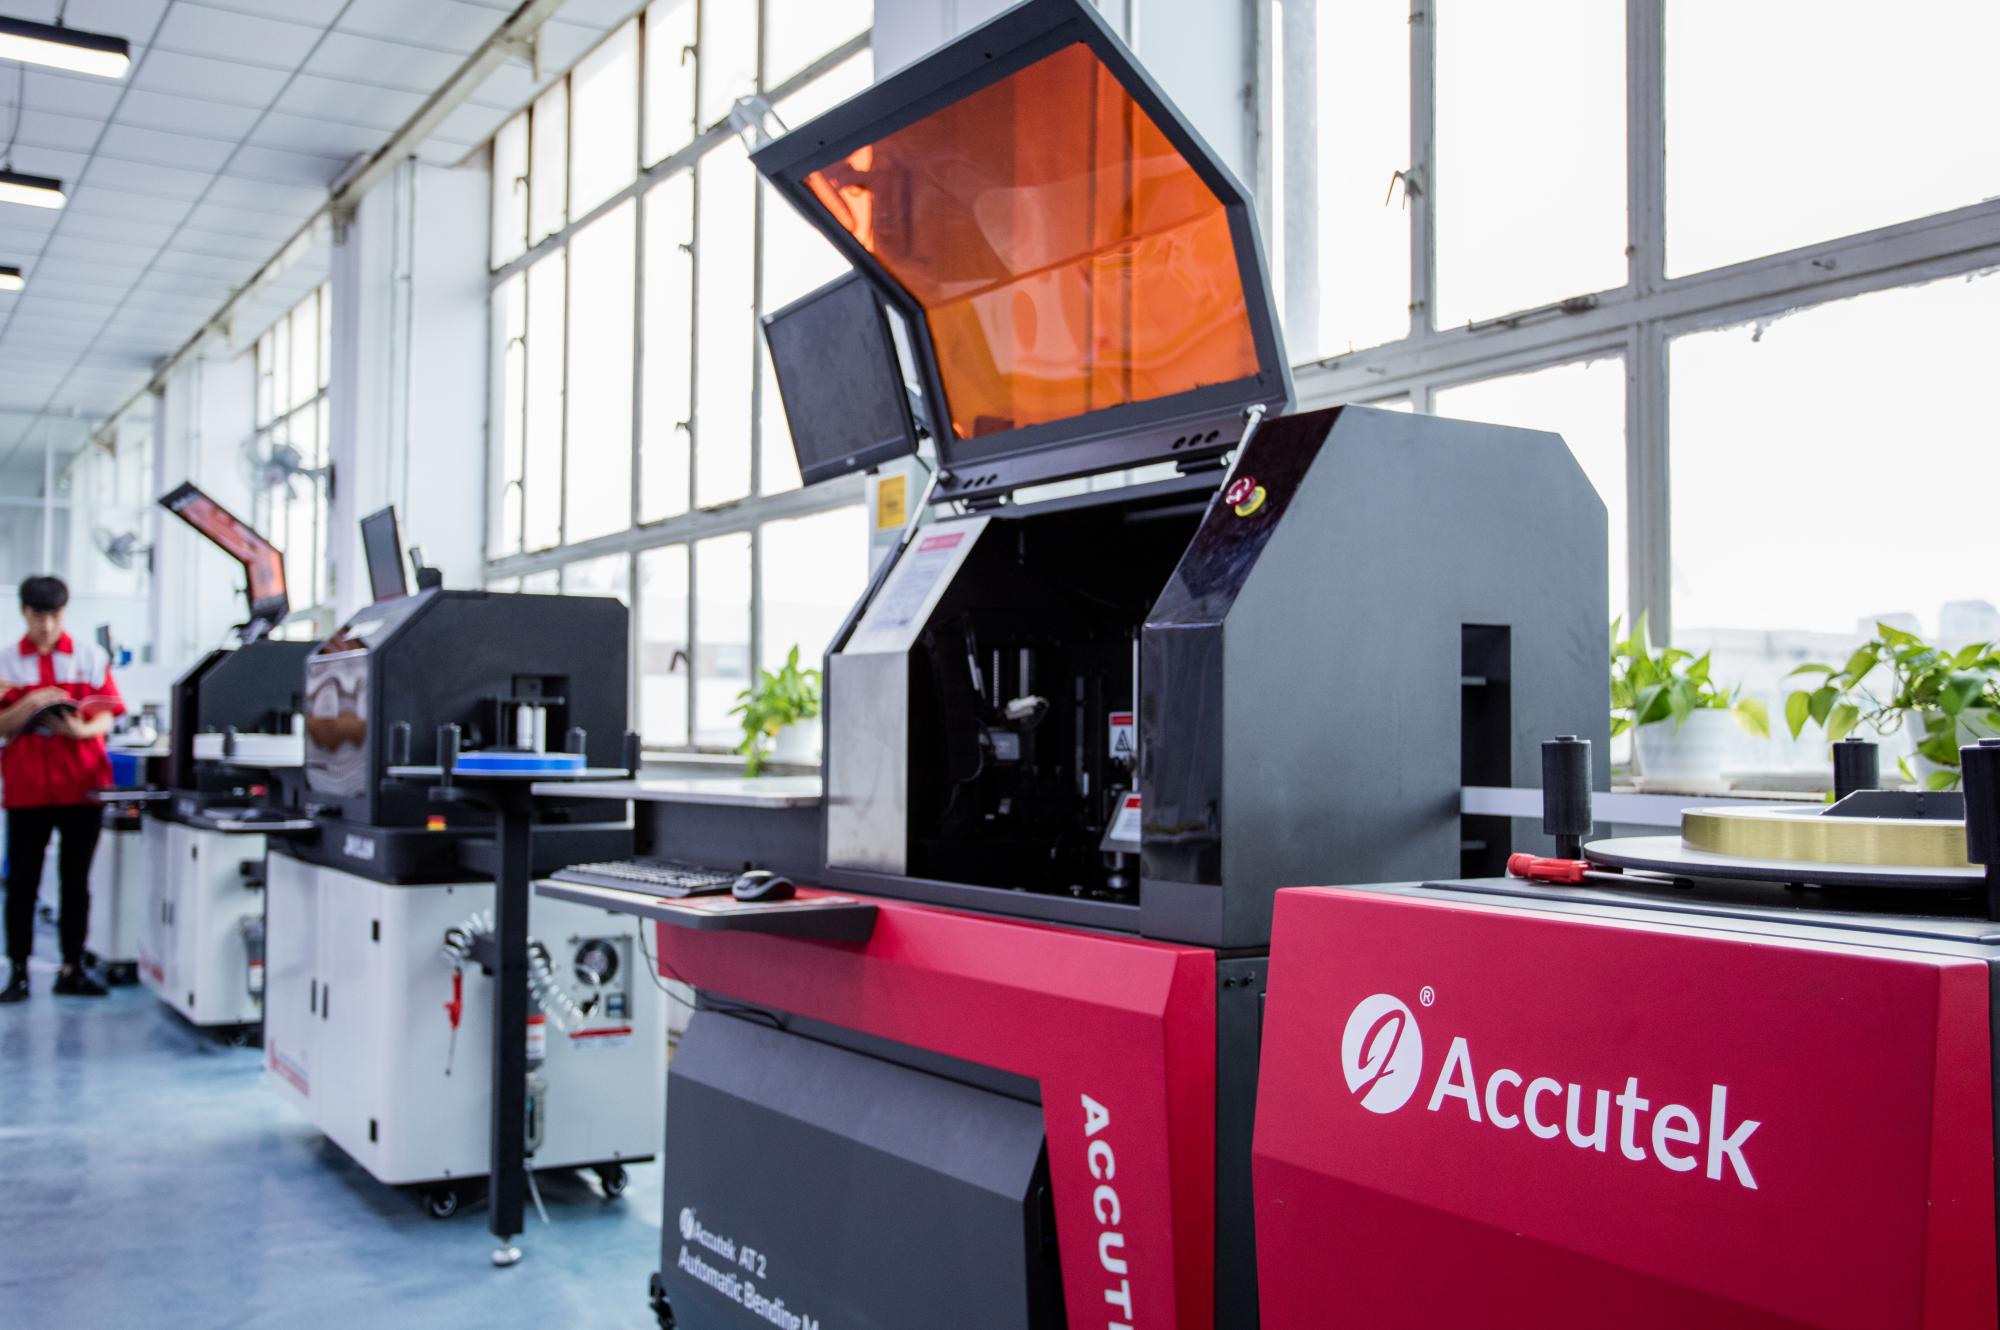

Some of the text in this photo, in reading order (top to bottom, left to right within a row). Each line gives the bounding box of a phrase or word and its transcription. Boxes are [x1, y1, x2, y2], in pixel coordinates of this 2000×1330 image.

[1427, 1036, 1761, 1190] Accutek
[738, 1245, 758, 1273] AT
[756, 1253, 768, 1280] 2
[1081, 1093, 1134, 1330] ACCUT
[677, 1244, 744, 1305] Automatic
